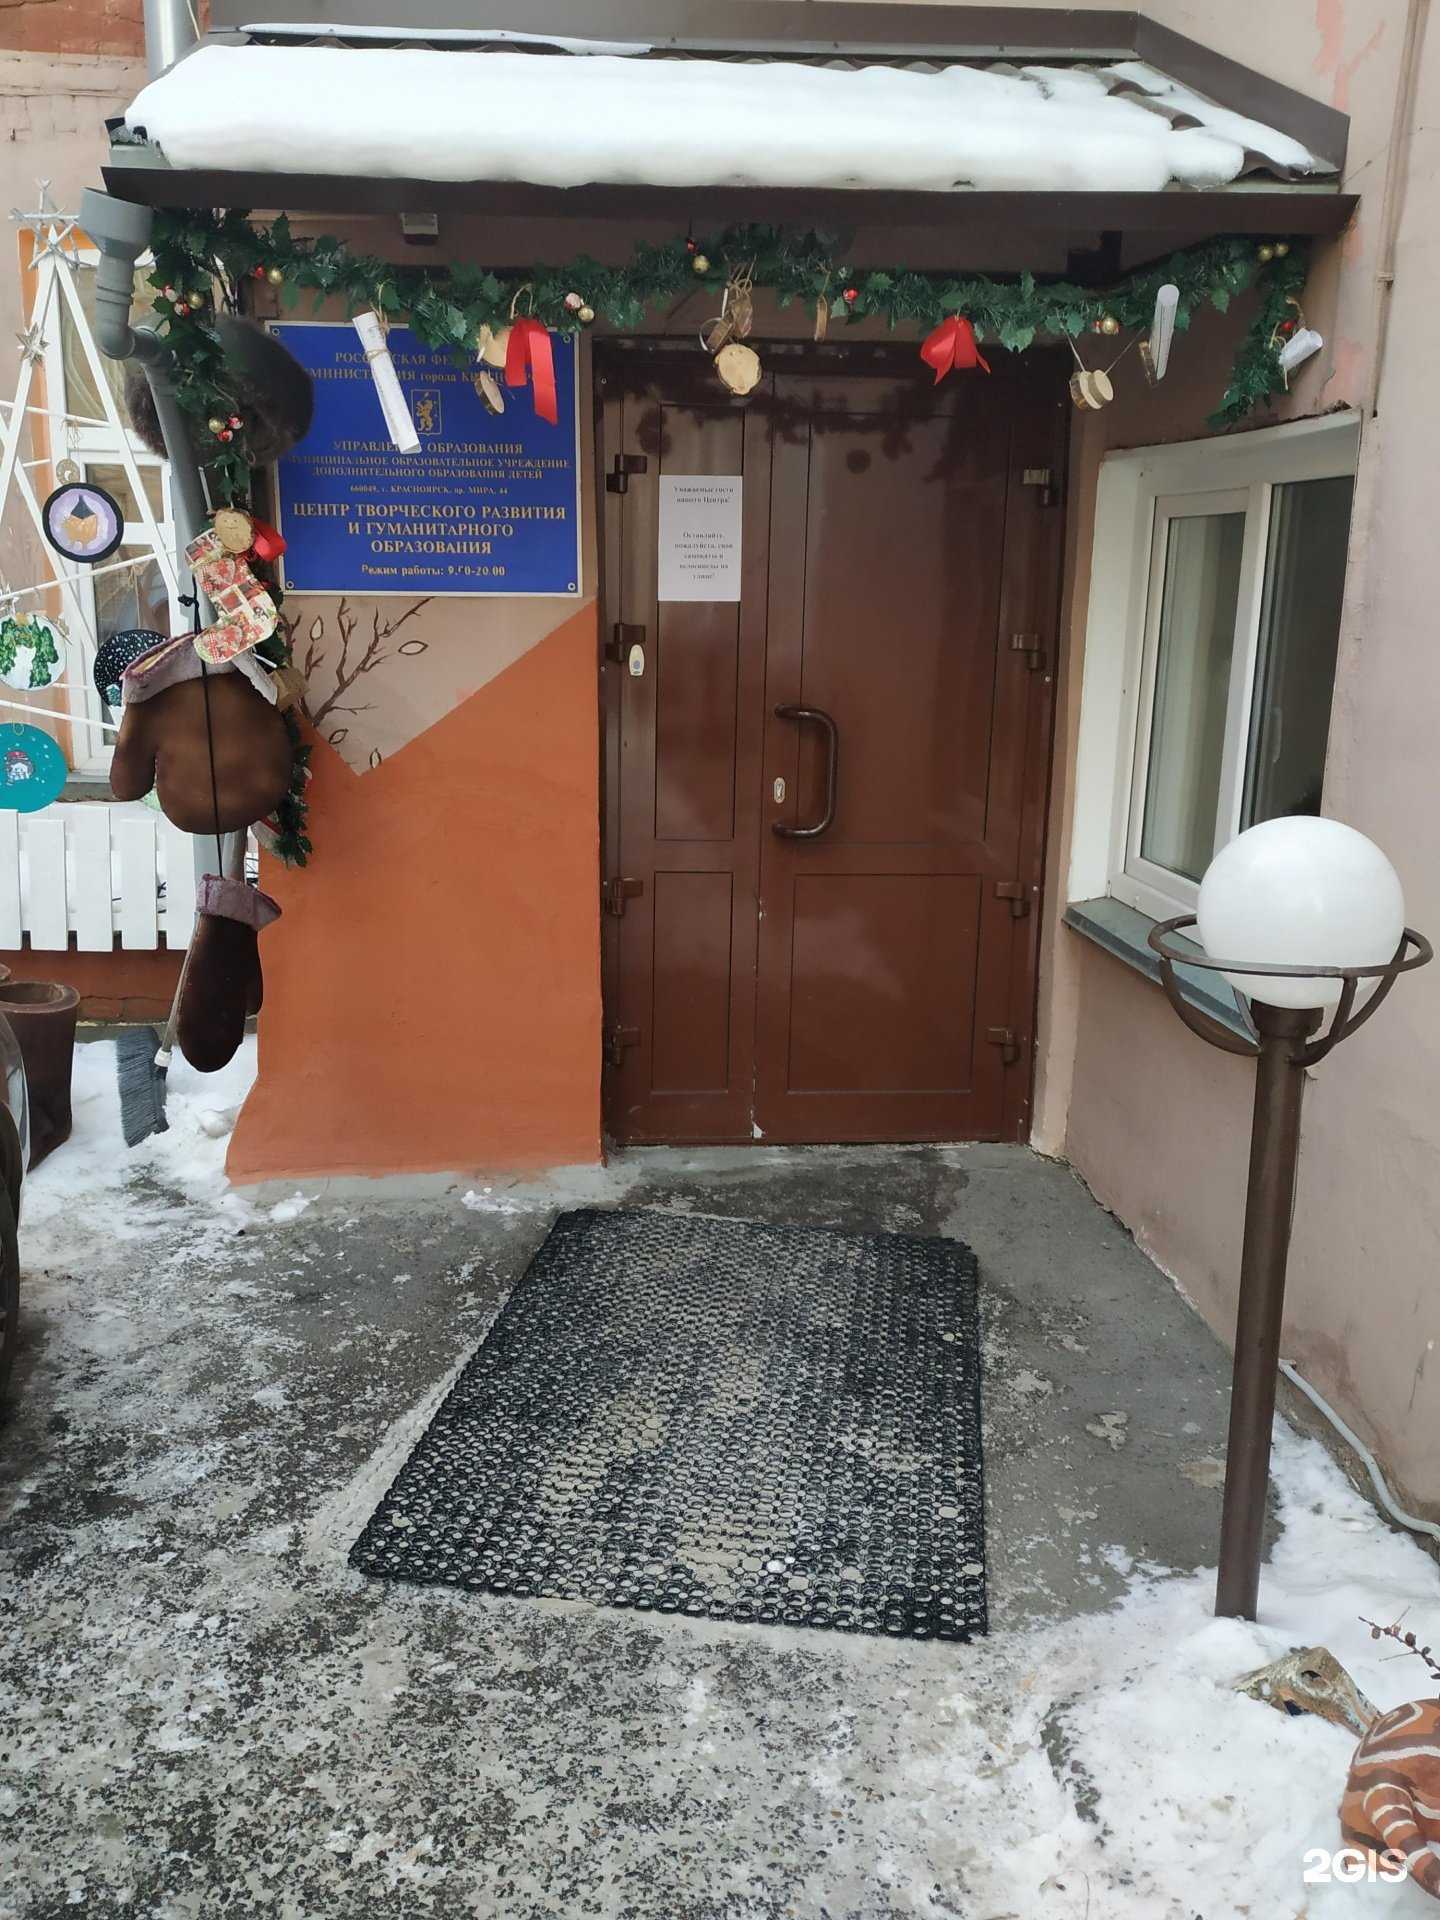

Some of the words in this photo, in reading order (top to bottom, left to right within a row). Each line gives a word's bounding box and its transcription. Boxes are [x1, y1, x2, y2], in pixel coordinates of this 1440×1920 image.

[421, 373, 456, 383] города
[427, 443, 523, 454] ОБРАЗОВАНИЯ
[392, 456, 493, 467] ОБРАЗОВАТЕЛЬНОЕ
[498, 459, 569, 468] УЧРЕЖДЕНИЕ
[313, 466, 425, 477] ДОПОЛНИТЕЛЬНОГО
[428, 469, 505, 478] ОБРАЗОВАНИЯ
[509, 468, 543, 479] ДЕТЕЙ
[294, 503, 349, 517] ЦЕНТР
[355, 504, 476, 518] ТВОРЧЕСКОГО
[482, 506, 566, 519] РАЗВИТИЯ
[348, 522, 360, 534] И
[366, 522, 513, 536] ГУМАНИТАРНОГО
[371, 540, 492, 554] ОБРАЗОВАНИЯ
[362, 564, 397, 575] Режим
[402, 565, 444, 577] работы:
